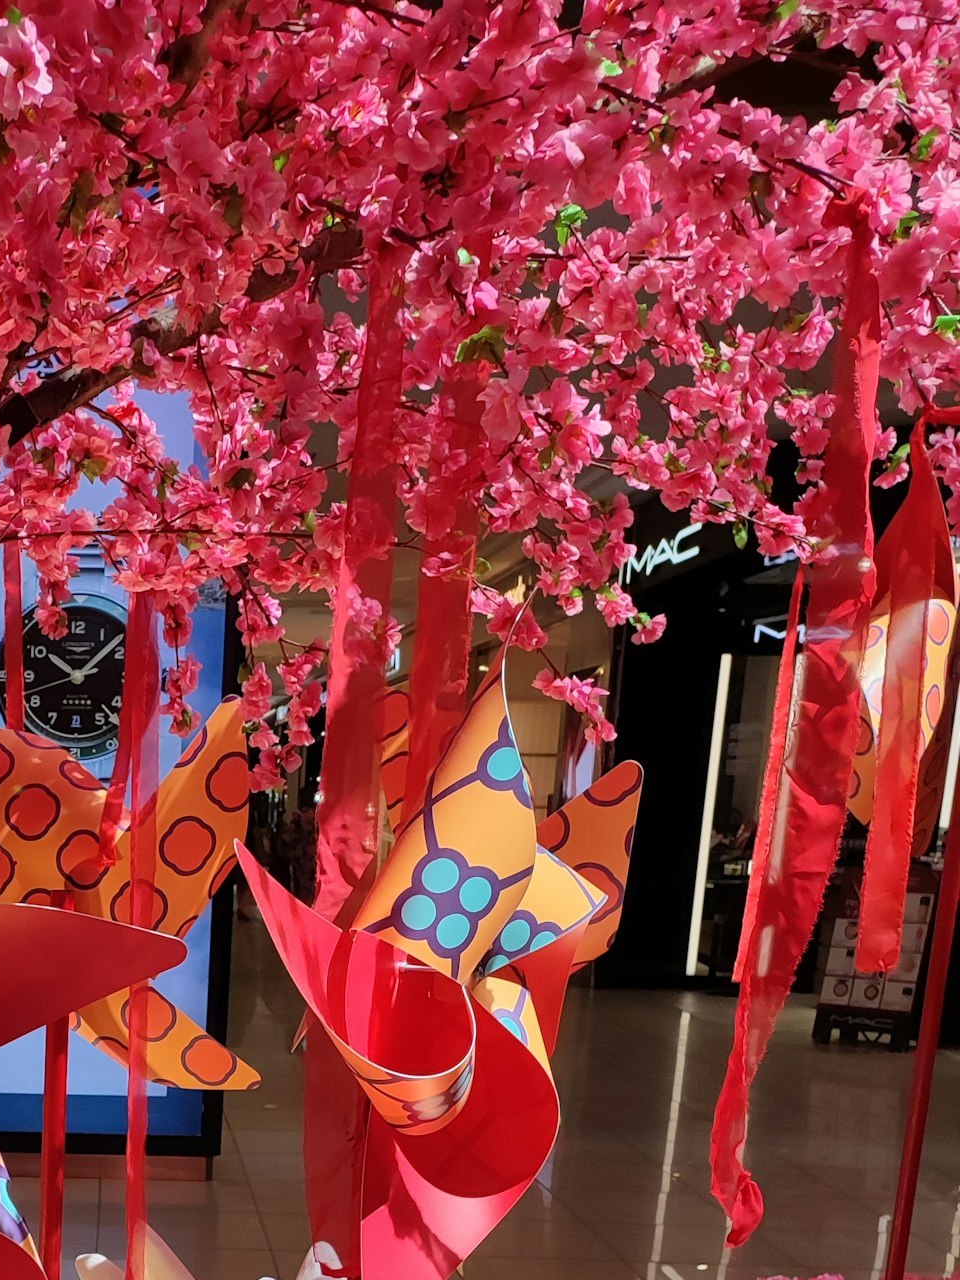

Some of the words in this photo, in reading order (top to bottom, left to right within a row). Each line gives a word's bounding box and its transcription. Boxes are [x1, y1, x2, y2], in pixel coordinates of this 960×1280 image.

[71, 620, 86, 634] 12
[100, 627, 105, 641] 1
[30, 645, 47, 658] 10
[114, 646, 125, 659] 2
[23, 669, 35, 682] 9
[30, 694, 41, 708] 8
[111, 695, 123, 708] 4
[47, 712, 58, 725] 7
[94, 712, 105, 725] 5
